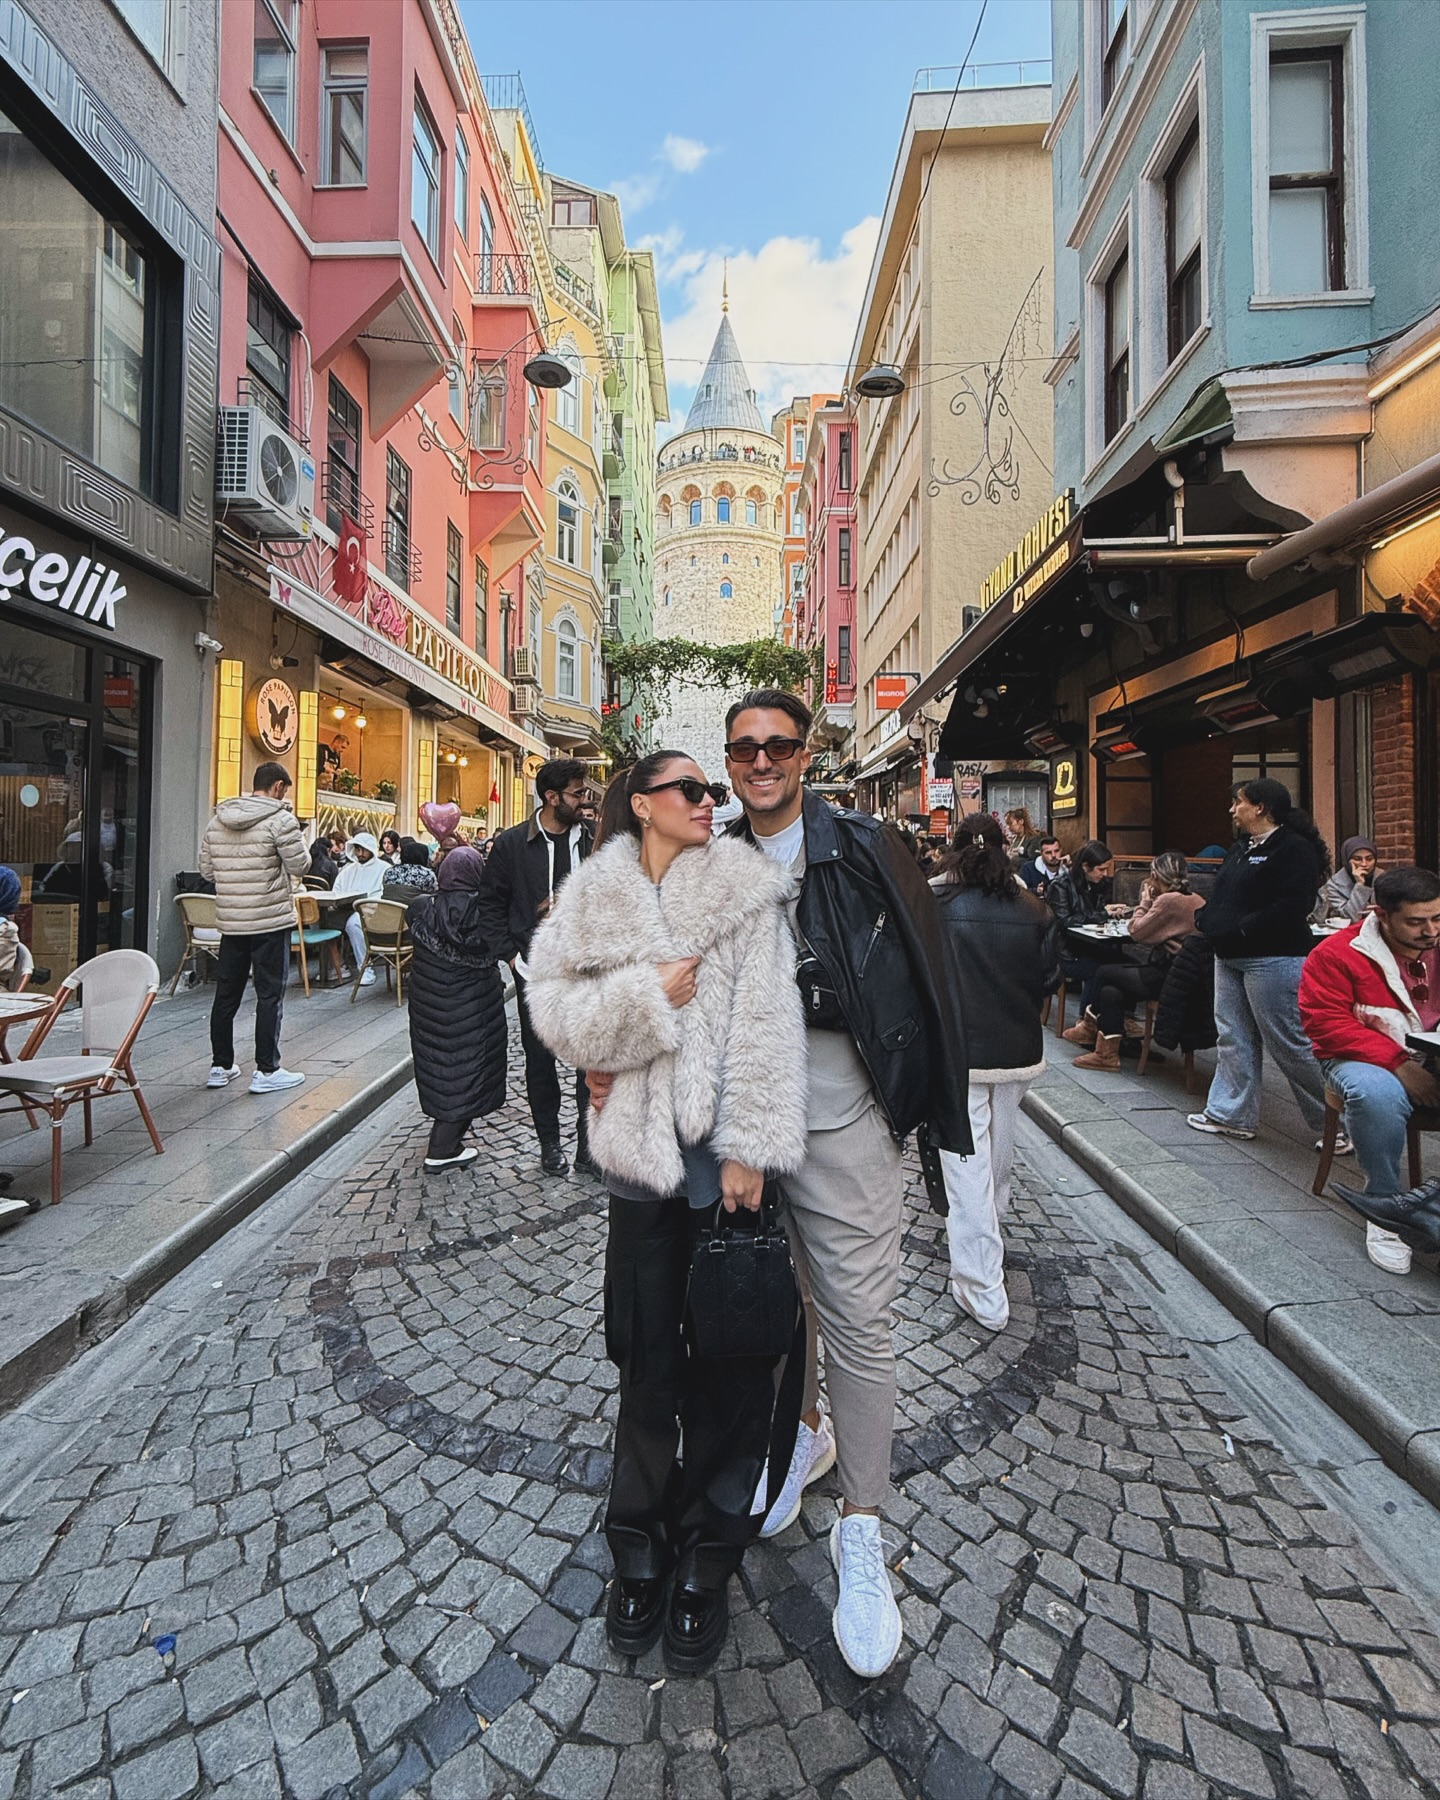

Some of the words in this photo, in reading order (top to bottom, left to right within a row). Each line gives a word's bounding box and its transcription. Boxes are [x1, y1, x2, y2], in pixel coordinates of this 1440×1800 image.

[0, 527, 127, 629] çelik
[362, 635, 384, 662] ROSE
[260, 683, 273, 705] ROSE
[273, 682, 296, 715] PAPILLON
